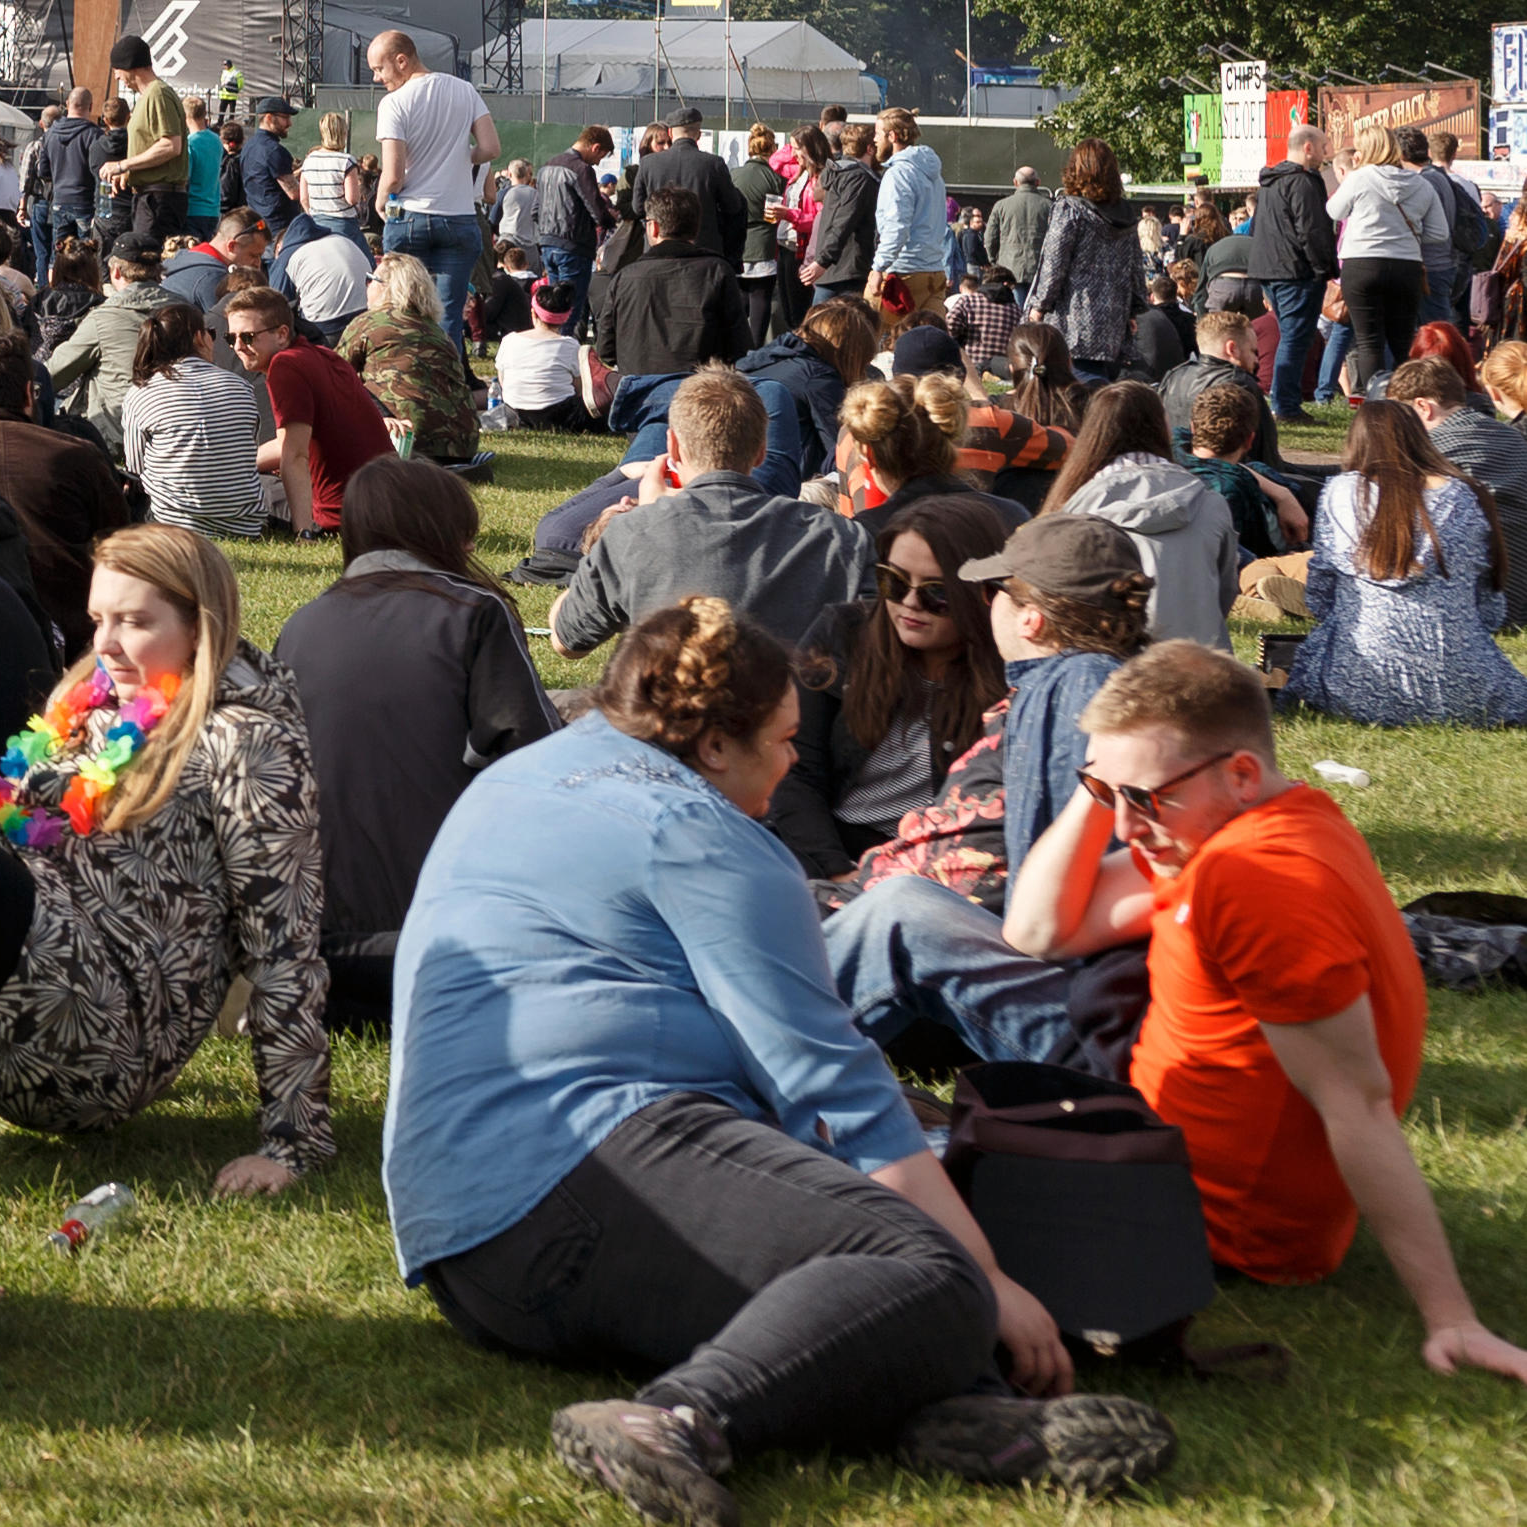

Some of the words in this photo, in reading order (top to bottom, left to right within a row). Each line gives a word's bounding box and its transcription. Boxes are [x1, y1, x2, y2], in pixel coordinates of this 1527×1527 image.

[1226, 65, 1262, 90] CHIPS
[1211, 102, 1240, 139] TASTE
[1242, 101, 1256, 139] OF
[1391, 93, 1427, 128] SHACK
